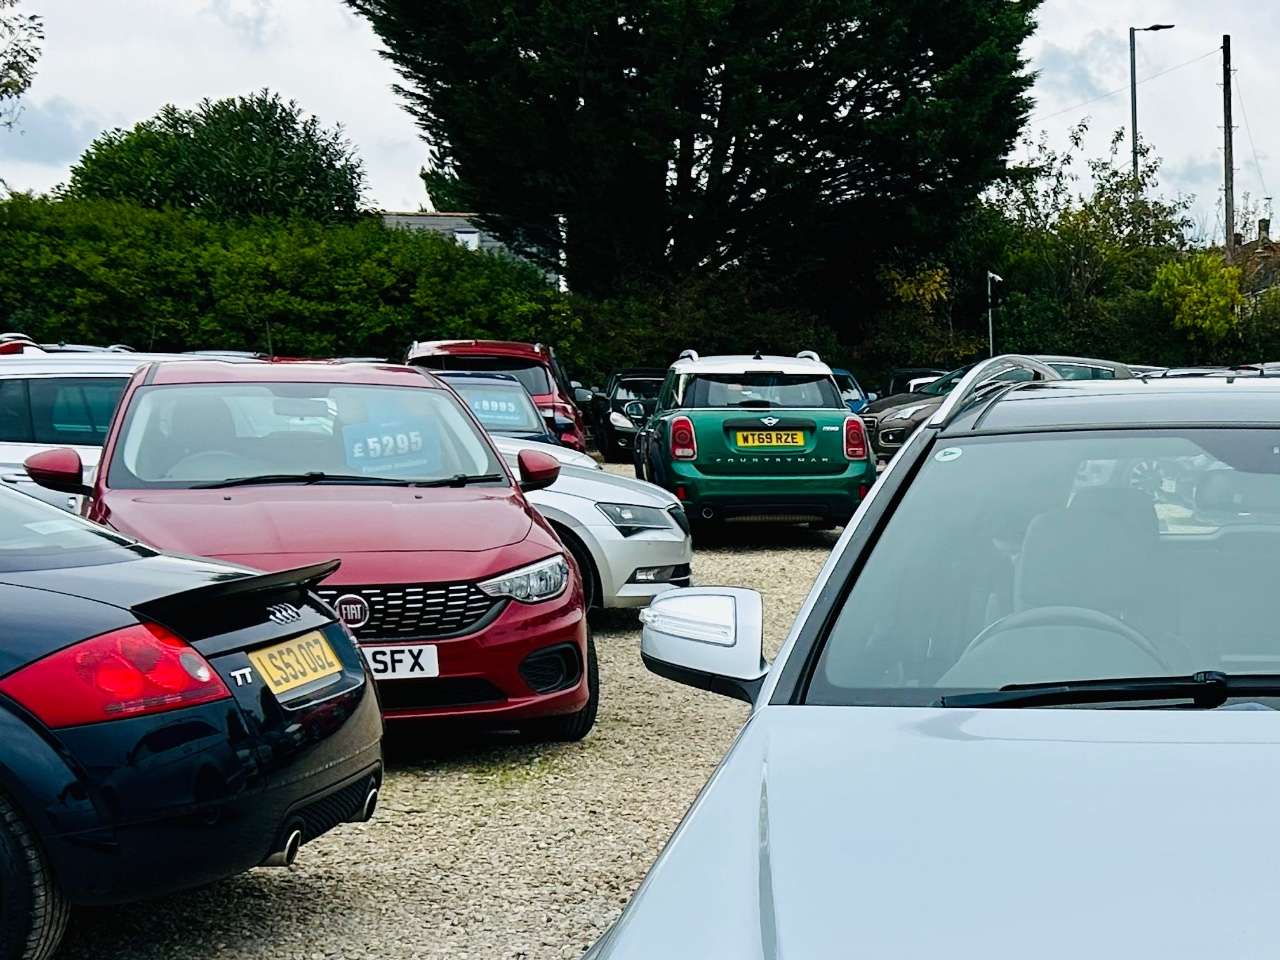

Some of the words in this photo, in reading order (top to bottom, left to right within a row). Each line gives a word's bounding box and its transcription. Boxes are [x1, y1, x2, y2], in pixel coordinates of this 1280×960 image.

[741, 433, 773, 444] WT69
[775, 432, 798, 443] RZE
[341, 604, 362, 620] FIAT
[371, 648, 425, 674] SFX
[230, 666, 253, 687] TT
